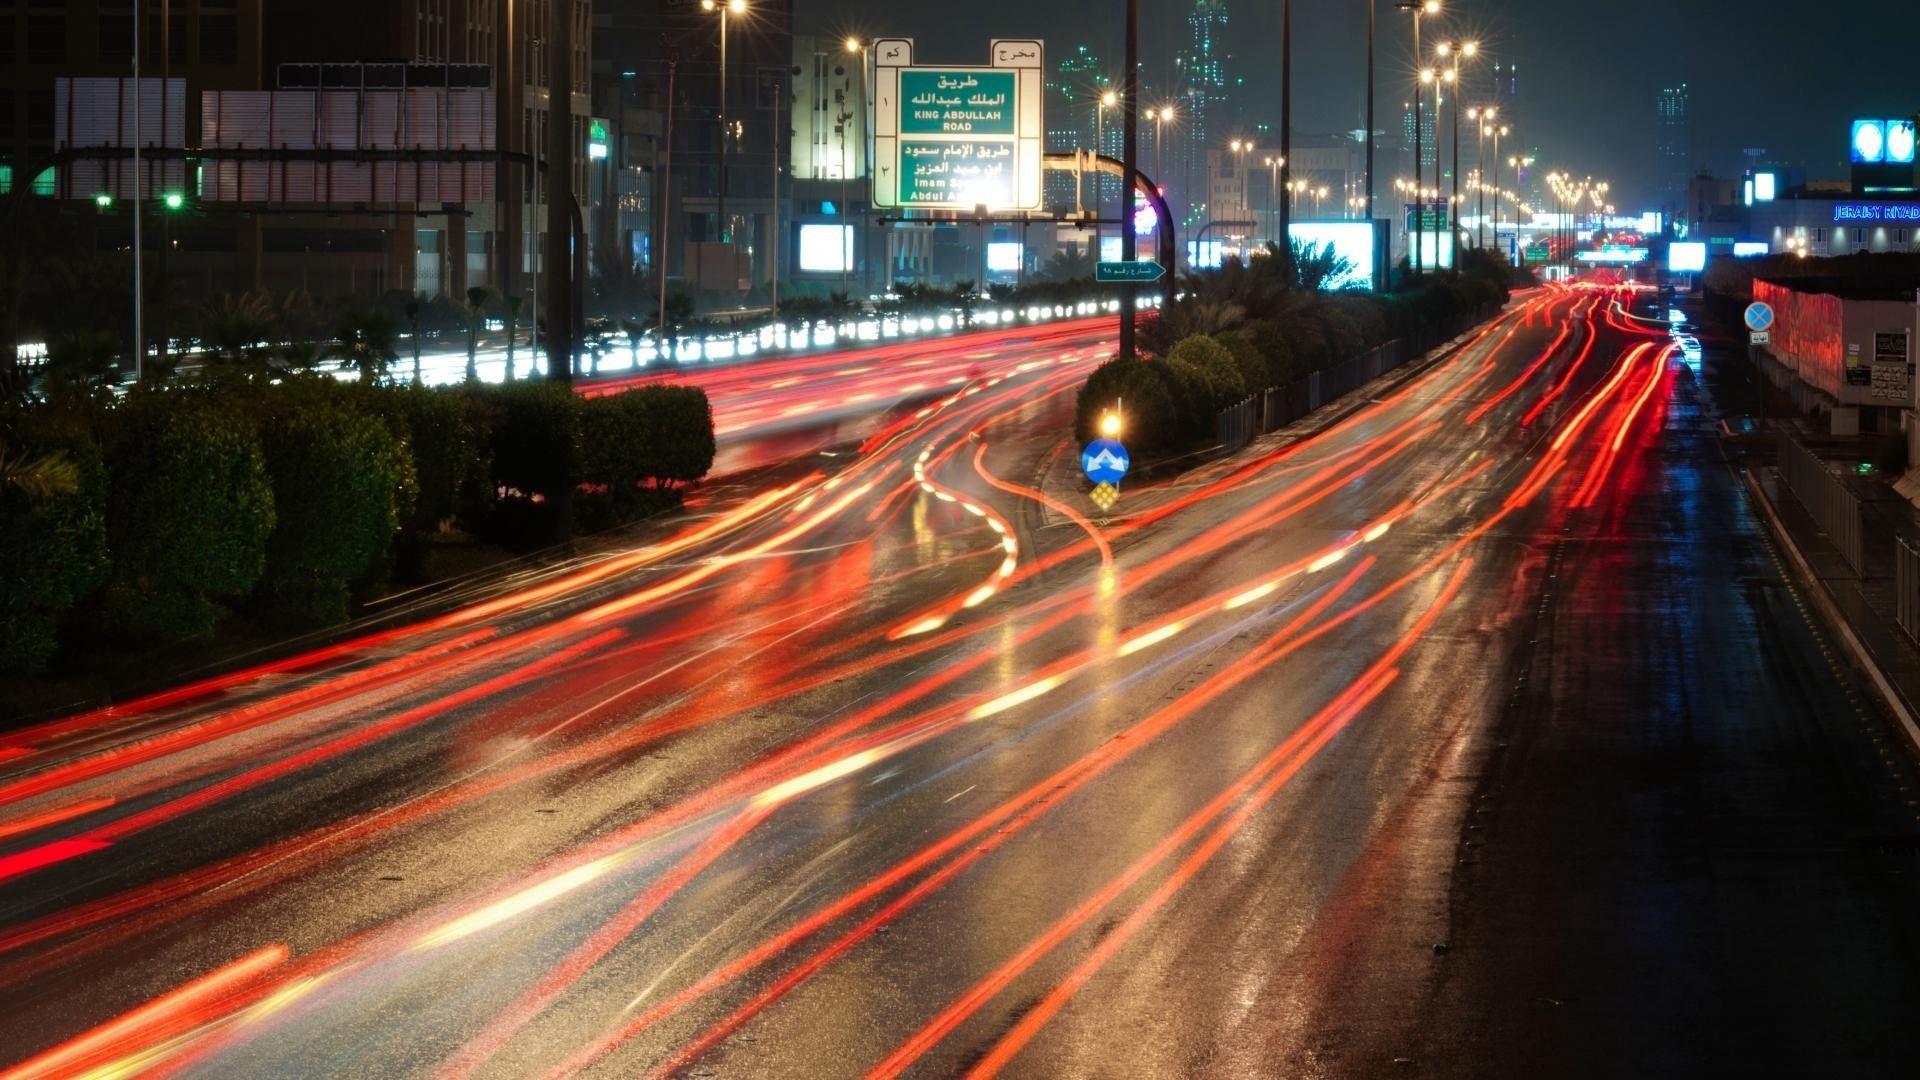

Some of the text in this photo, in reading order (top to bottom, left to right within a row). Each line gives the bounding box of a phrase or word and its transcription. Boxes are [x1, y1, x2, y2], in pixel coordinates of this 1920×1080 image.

[999, 49, 1036, 61] مخرج
[937, 75, 979, 89] طريق
[967, 93, 1005, 106] الملك
[914, 110, 1001, 120] KING ABDULLAH
[943, 122, 972, 131] ROAD
[905, 146, 939, 157] سعود
[976, 144, 1010, 158] طريق
[914, 161, 949, 175] العزيز
[914, 178, 946, 187] Imam
[910, 191, 943, 200] Abdul
[1834, 206, 1880, 221] JERAISY
